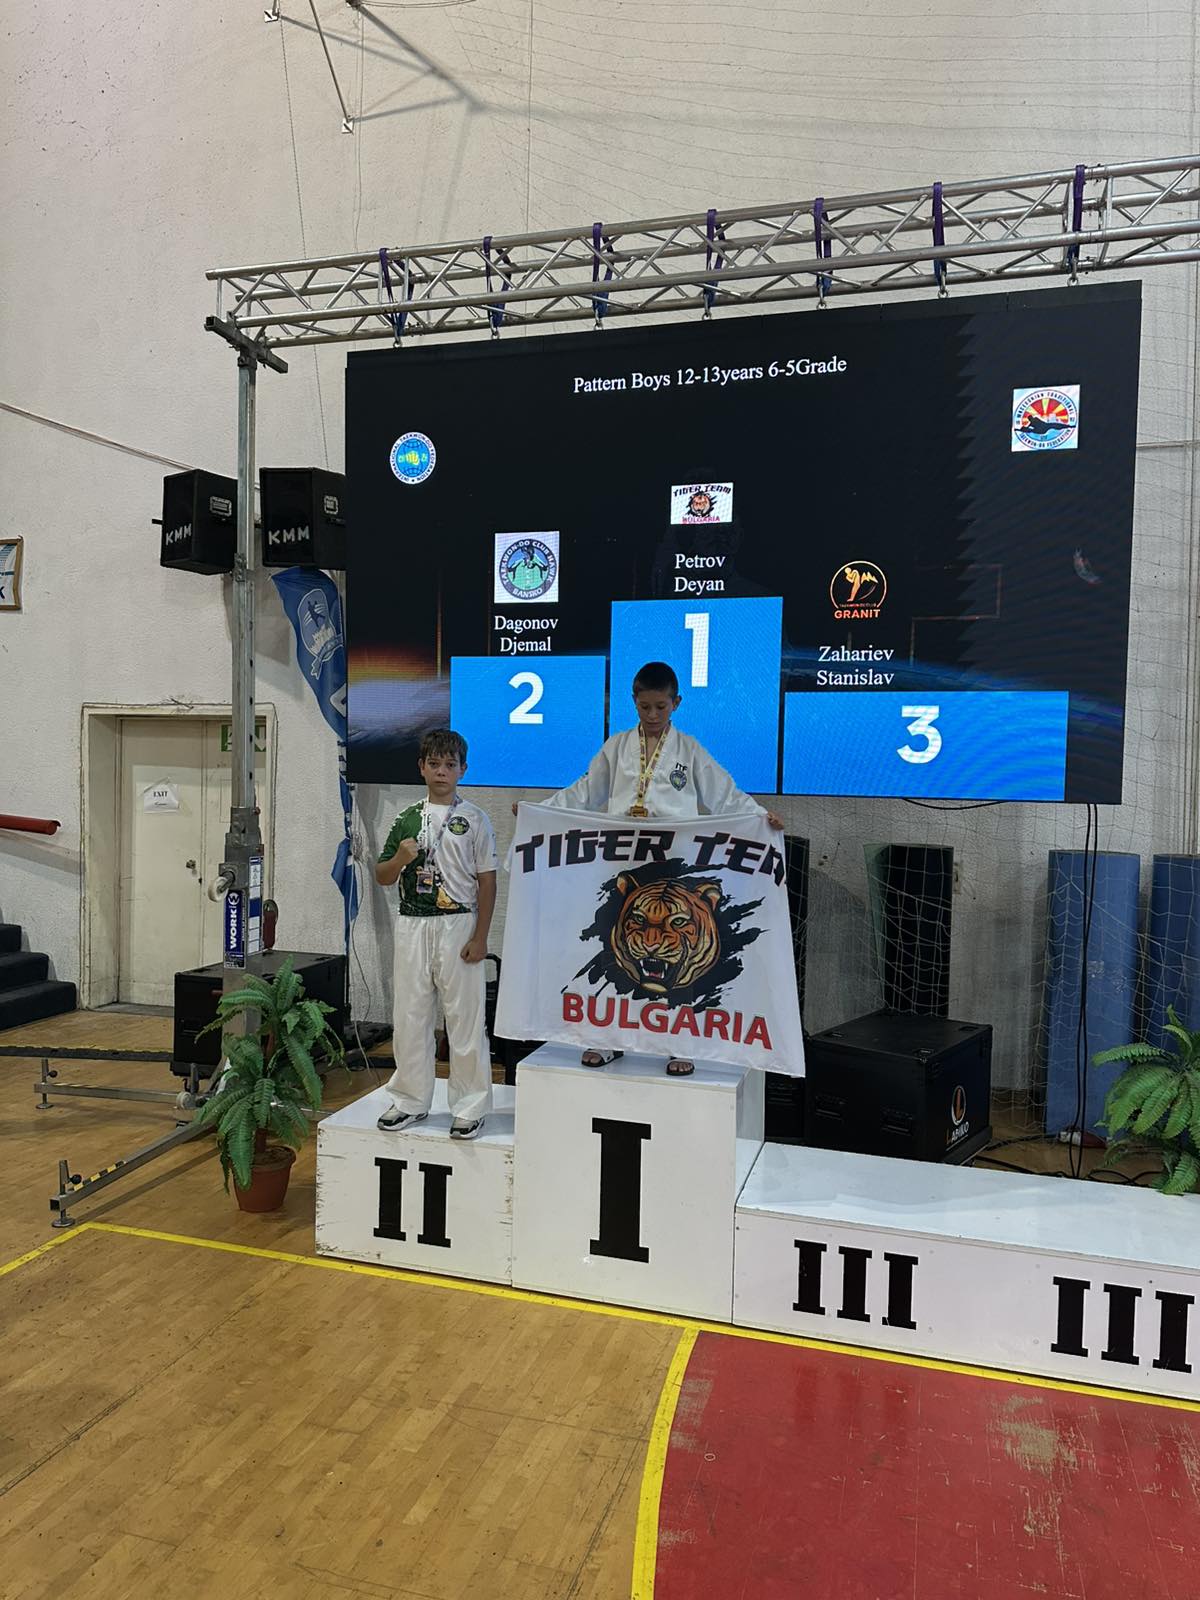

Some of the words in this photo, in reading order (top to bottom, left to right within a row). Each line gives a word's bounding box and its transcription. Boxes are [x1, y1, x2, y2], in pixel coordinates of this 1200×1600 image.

[573, 376, 626, 393] Pattern
[631, 372, 671, 391] Boys
[676, 363, 763, 386] 12-13years
[768, 355, 847, 377] 6-5Grade
[166, 523, 192, 546] KMM
[268, 525, 310, 545] KMM
[532, 541, 549, 556] CLUB
[674, 553, 725, 569] Petrov
[513, 587, 543, 599] BANSKO
[674, 576, 725, 596] Deyan
[494, 615, 558, 634] Dagonov
[834, 608, 880, 619] GRANIT
[500, 636, 551, 655] Djemal
[685, 613, 710, 687] 1
[818, 645, 894, 662] Zahariev
[816, 668, 894, 686] Stanislav
[508, 671, 544, 724] 2
[897, 705, 942, 763] 3
[675, 762, 688, 772] ITF
[515, 829, 676, 873] TIGER
[693, 832, 785, 887] TEA
[229, 908, 238, 950] WORK
[562, 993, 773, 1050] BULGARIA
[589, 1117, 652, 1264] I
[373, 1157, 453, 1249] II
[793, 1239, 919, 1331] III
[1051, 1276, 1195, 1374] III
